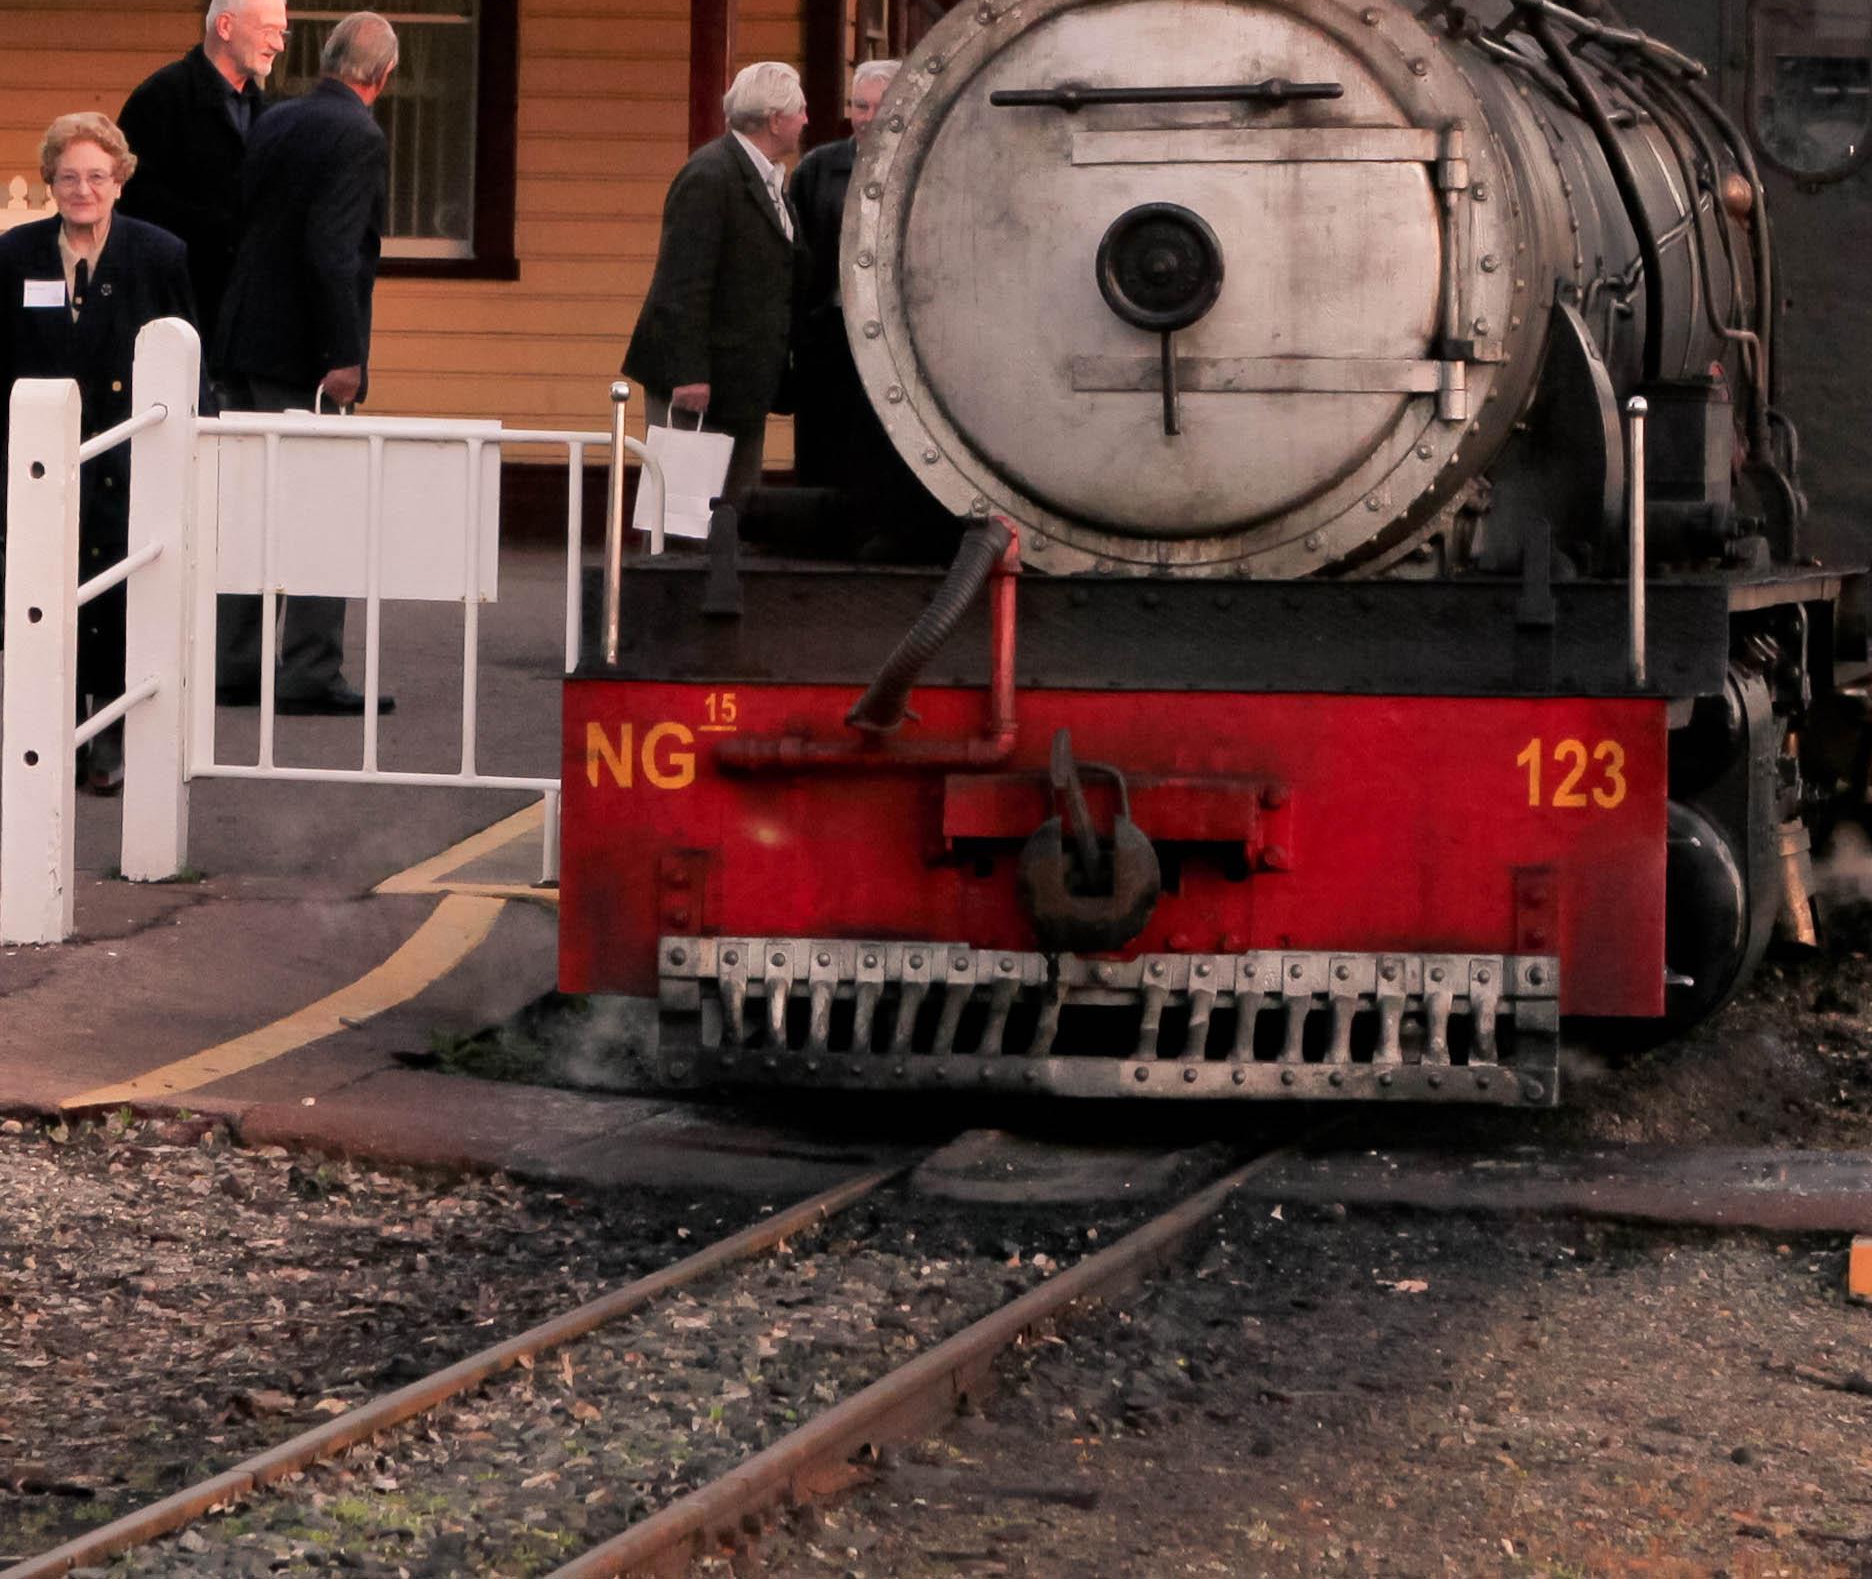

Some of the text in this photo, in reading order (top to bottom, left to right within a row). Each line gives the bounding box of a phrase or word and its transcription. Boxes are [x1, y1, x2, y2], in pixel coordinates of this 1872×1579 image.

[586, 692, 737, 790] NG 15
[1516, 737, 1627, 810] 123
